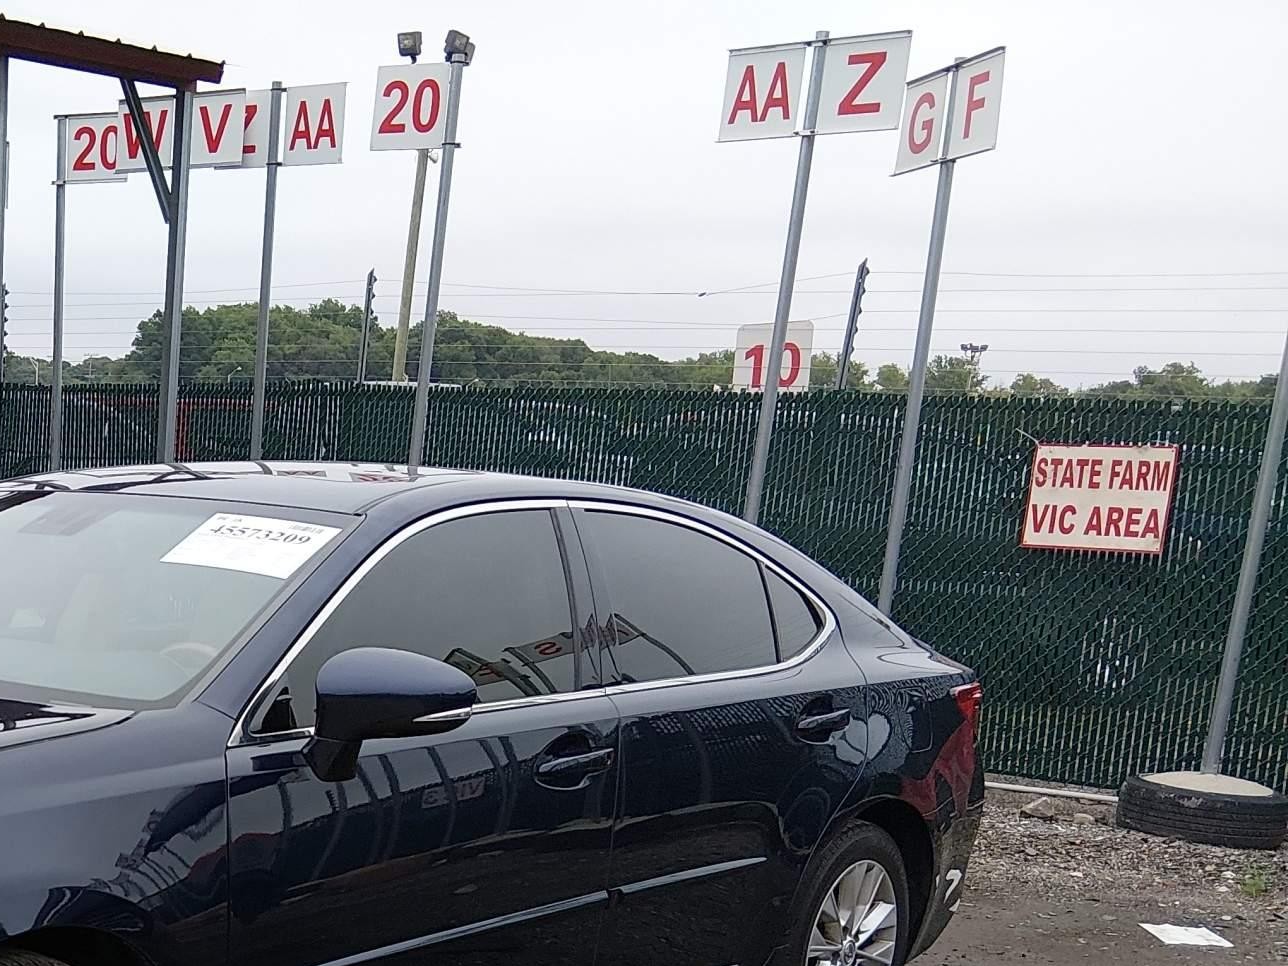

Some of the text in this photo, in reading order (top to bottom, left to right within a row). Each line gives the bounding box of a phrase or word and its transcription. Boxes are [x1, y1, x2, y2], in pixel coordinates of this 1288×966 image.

[378, 78, 441, 135] 20
[728, 61, 790, 125] AA
[837, 51, 887, 116] Z
[962, 71, 991, 140] F
[123, 109, 168, 160] W
[199, 103, 232, 154] V
[289, 98, 337, 151] AA
[908, 91, 936, 155] G
[744, 342, 801, 389] 10
[1034, 457, 1171, 492] STATE FARM
[209, 524, 311, 545] 45573209
[1031, 503, 1160, 540] VIC AREA
